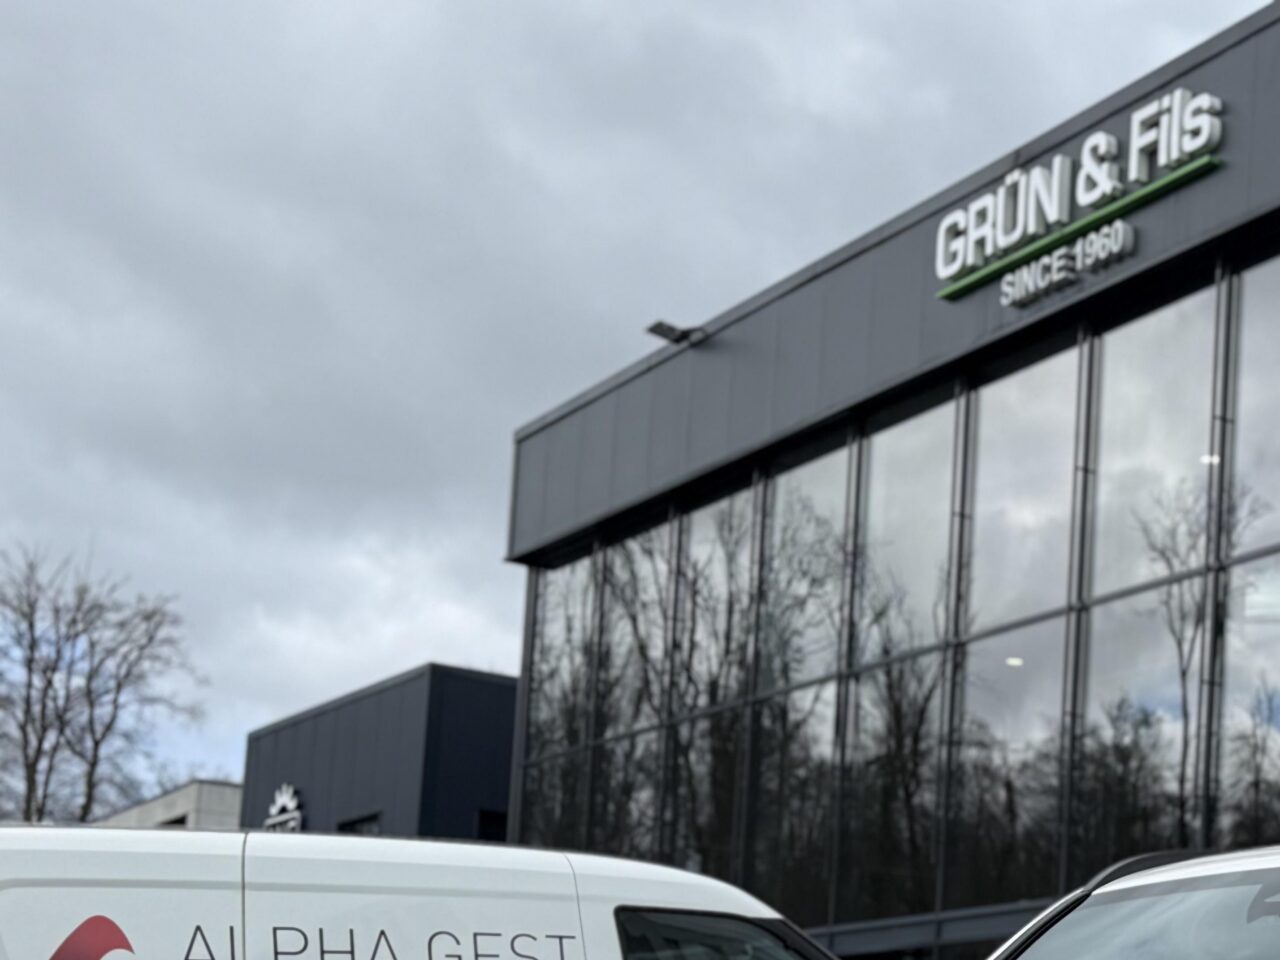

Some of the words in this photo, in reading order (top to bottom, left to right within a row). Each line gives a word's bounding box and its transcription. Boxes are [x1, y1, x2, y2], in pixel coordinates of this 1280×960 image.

[935, 154, 1069, 280] GRÜN
[1076, 130, 1120, 208] &
[1128, 87, 1222, 182] Fils
[1000, 245, 1070, 306] SINCE
[1075, 218, 1134, 271] 1960
